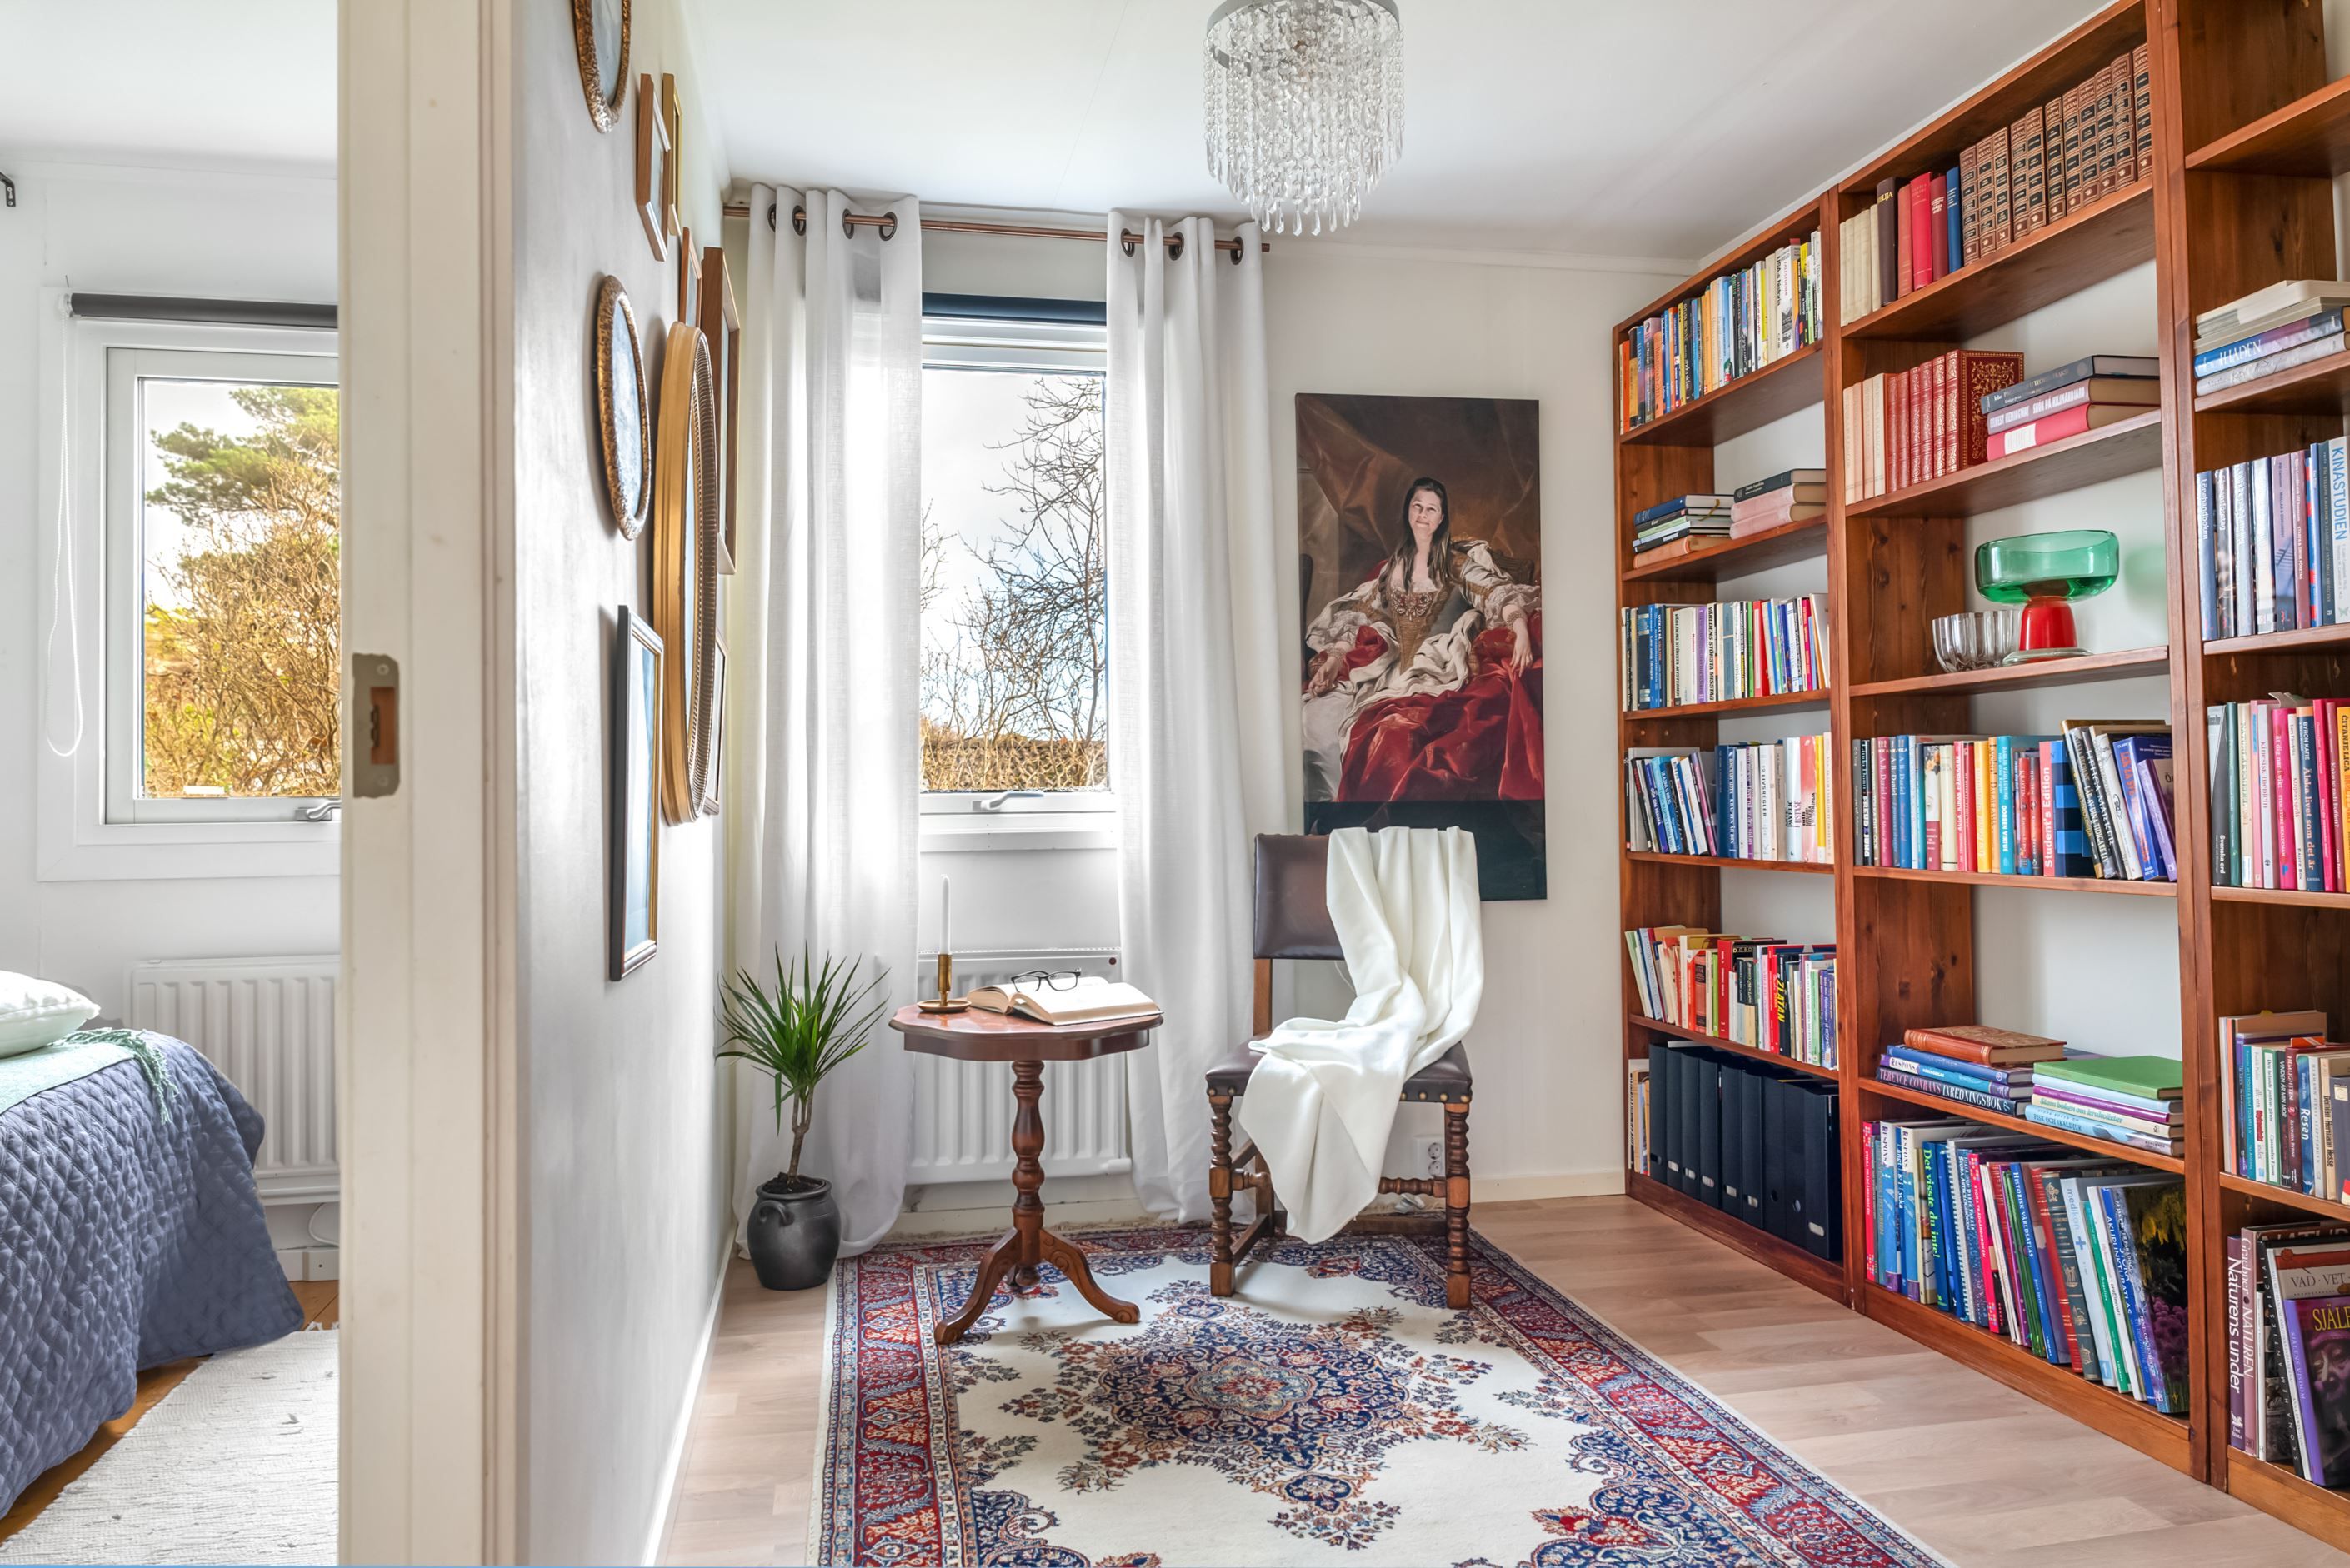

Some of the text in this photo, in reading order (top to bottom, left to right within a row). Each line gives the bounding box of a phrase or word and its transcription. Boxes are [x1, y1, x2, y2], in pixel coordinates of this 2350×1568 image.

[2201, 478, 2209, 540] Lönehandboken
[2332, 447, 2348, 541] KINASTUDIEN
[2083, 786, 2093, 800] LÄR
[2302, 767, 2313, 794] Älska
[2043, 767, 2053, 867] Student's Edition
[2088, 800, 2096, 808] AV
[2089, 808, 2098, 822] DINA
[2303, 796, 2313, 818] livet
[2092, 822, 2106, 851] TIDIGARE
[2307, 841, 2315, 857] det
[2308, 858, 2317, 871] är
[1777, 980, 1785, 1022] ZLATAN
[1879, 1069, 1908, 1083] TERENCE
[1909, 1077, 1942, 1094] CONRANS
[1942, 1086, 2002, 1111] INREDNINGSBOK
[2033, 1113, 2082, 1131] FISK OCH SKALDJUR
[2300, 1108, 2311, 1140] Resan
[2324, 1096, 2335, 1167] Demian Hermann Hesse
[1922, 1149, 1940, 1258] Det visste du inte!
[2013, 1171, 2034, 1258] HISTORISK VÄRLDSATLAS
[1976, 1205, 1986, 1258] TRÄDGÅRDSBOKEN
[2107, 1215, 2132, 1314] AKUPUNKTURATLAS
[2291, 1272, 2346, 1288] VAD VET
[2228, 1256, 2243, 1393] Naturens under
[2312, 1312, 2350, 1331] SJÄLE
[2242, 1315, 2253, 1377] NATUREN
[2297, 1368, 2306, 1400] VISDOM
